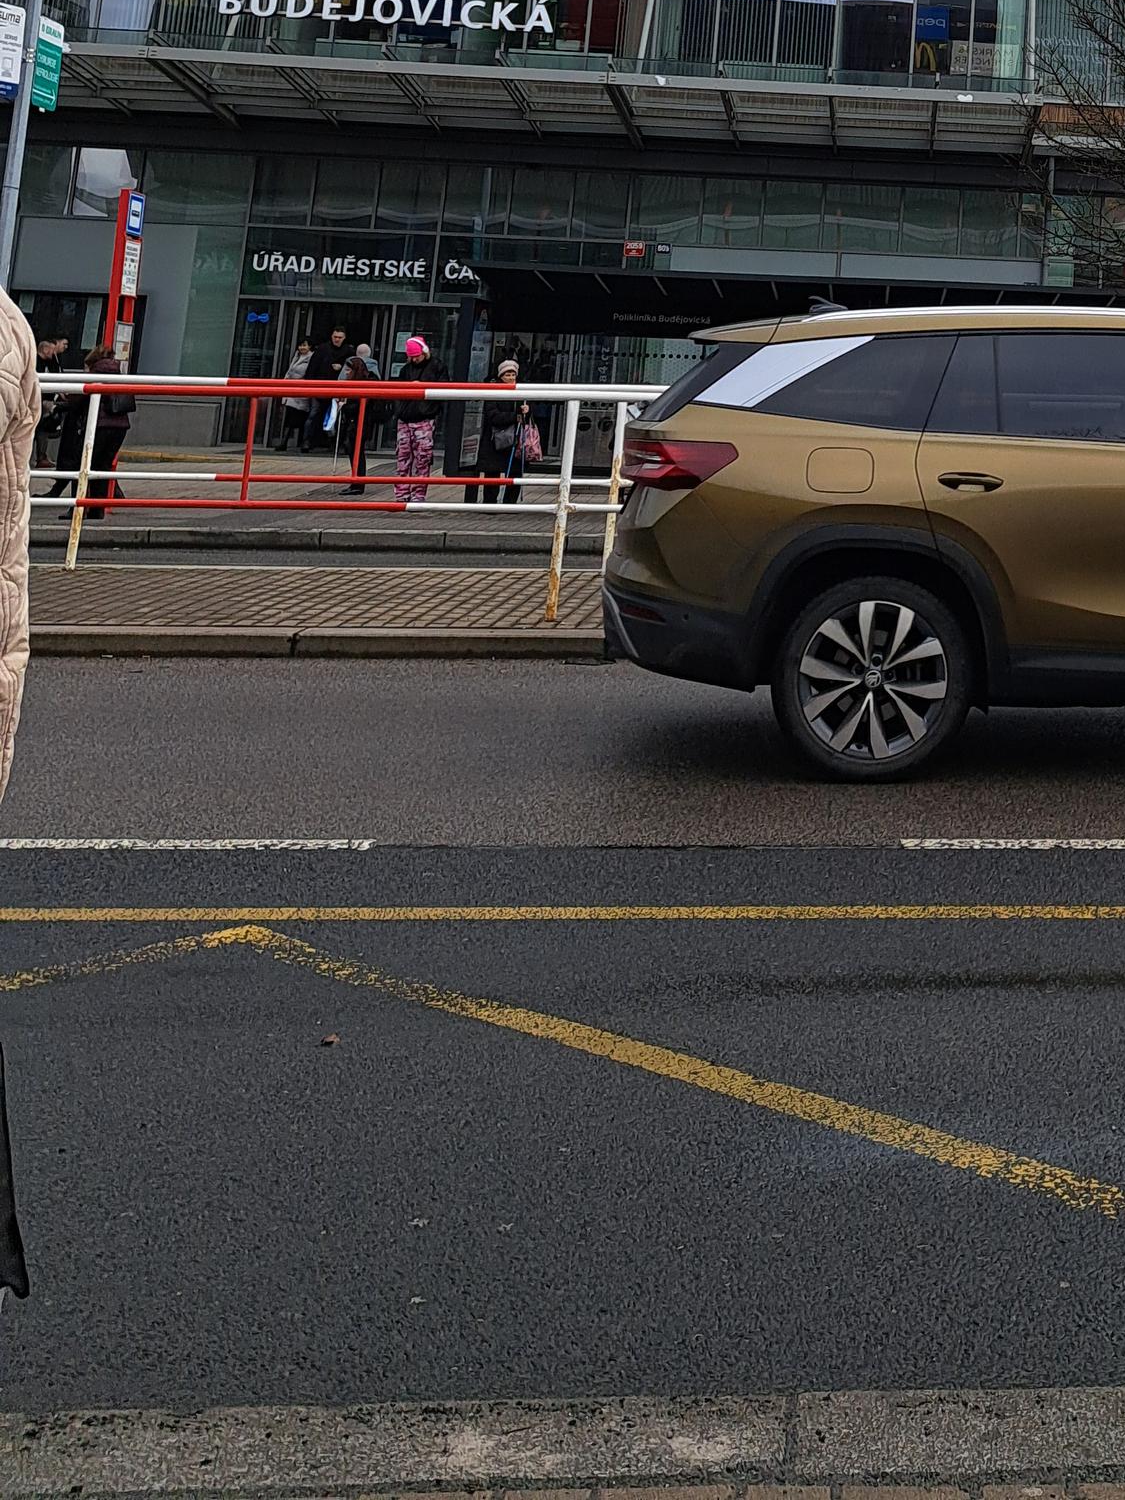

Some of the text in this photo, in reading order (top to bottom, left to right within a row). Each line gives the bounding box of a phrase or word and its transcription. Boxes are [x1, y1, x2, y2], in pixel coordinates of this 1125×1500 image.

[252, 251, 316, 273] ÚŘAD
[321, 255, 427, 278] MĚSTSKÉ
[613, 312, 711, 325] Poliklinika Budějovická
